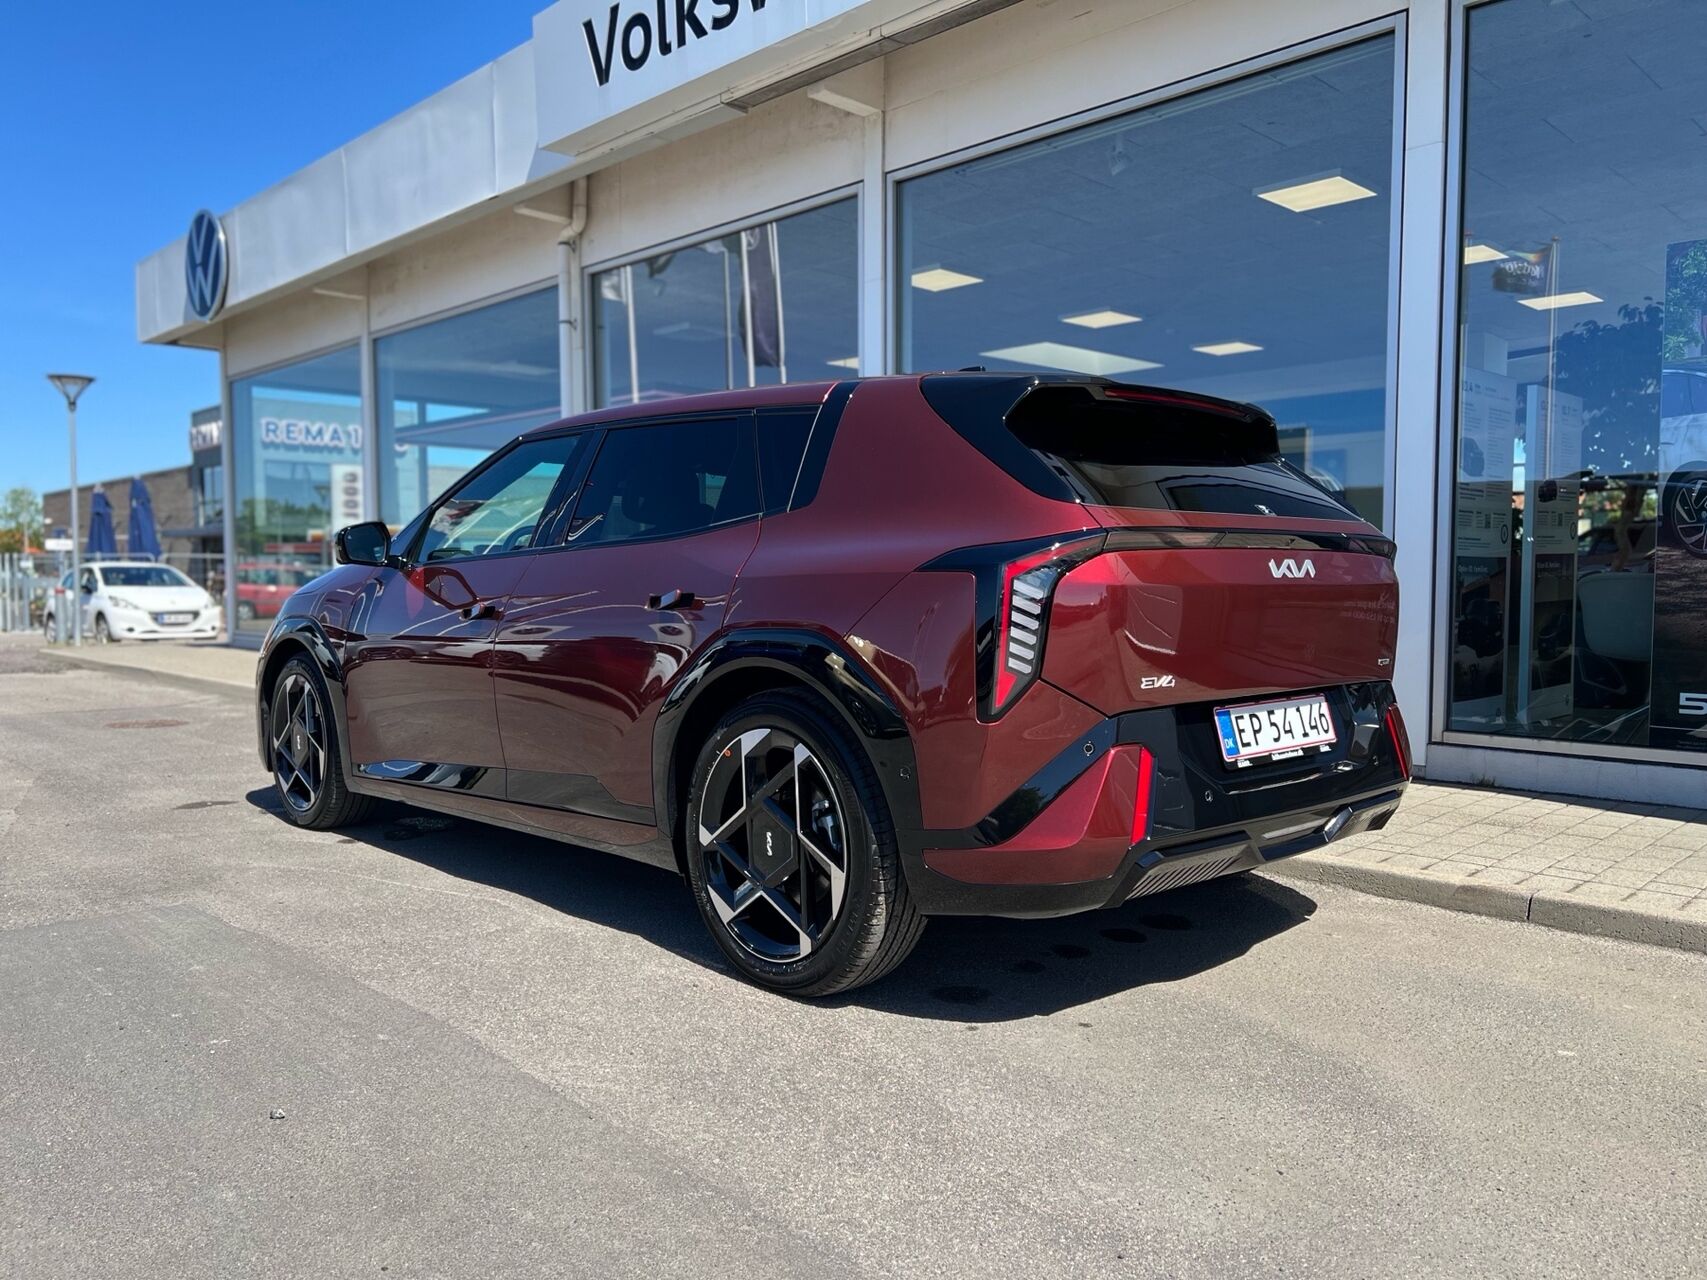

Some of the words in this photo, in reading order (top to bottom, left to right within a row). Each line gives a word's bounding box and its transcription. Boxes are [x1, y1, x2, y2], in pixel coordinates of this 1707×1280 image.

[582, 0, 768, 87] Volks
[263, 418, 344, 447] REMA
[1268, 558, 1317, 579] KIA
[1140, 674, 1177, 690] EV4
[1234, 713, 1263, 748] EP
[1266, 707, 1295, 743] 54
[1295, 701, 1330, 738] 146
[1223, 737, 1236, 750] DK
